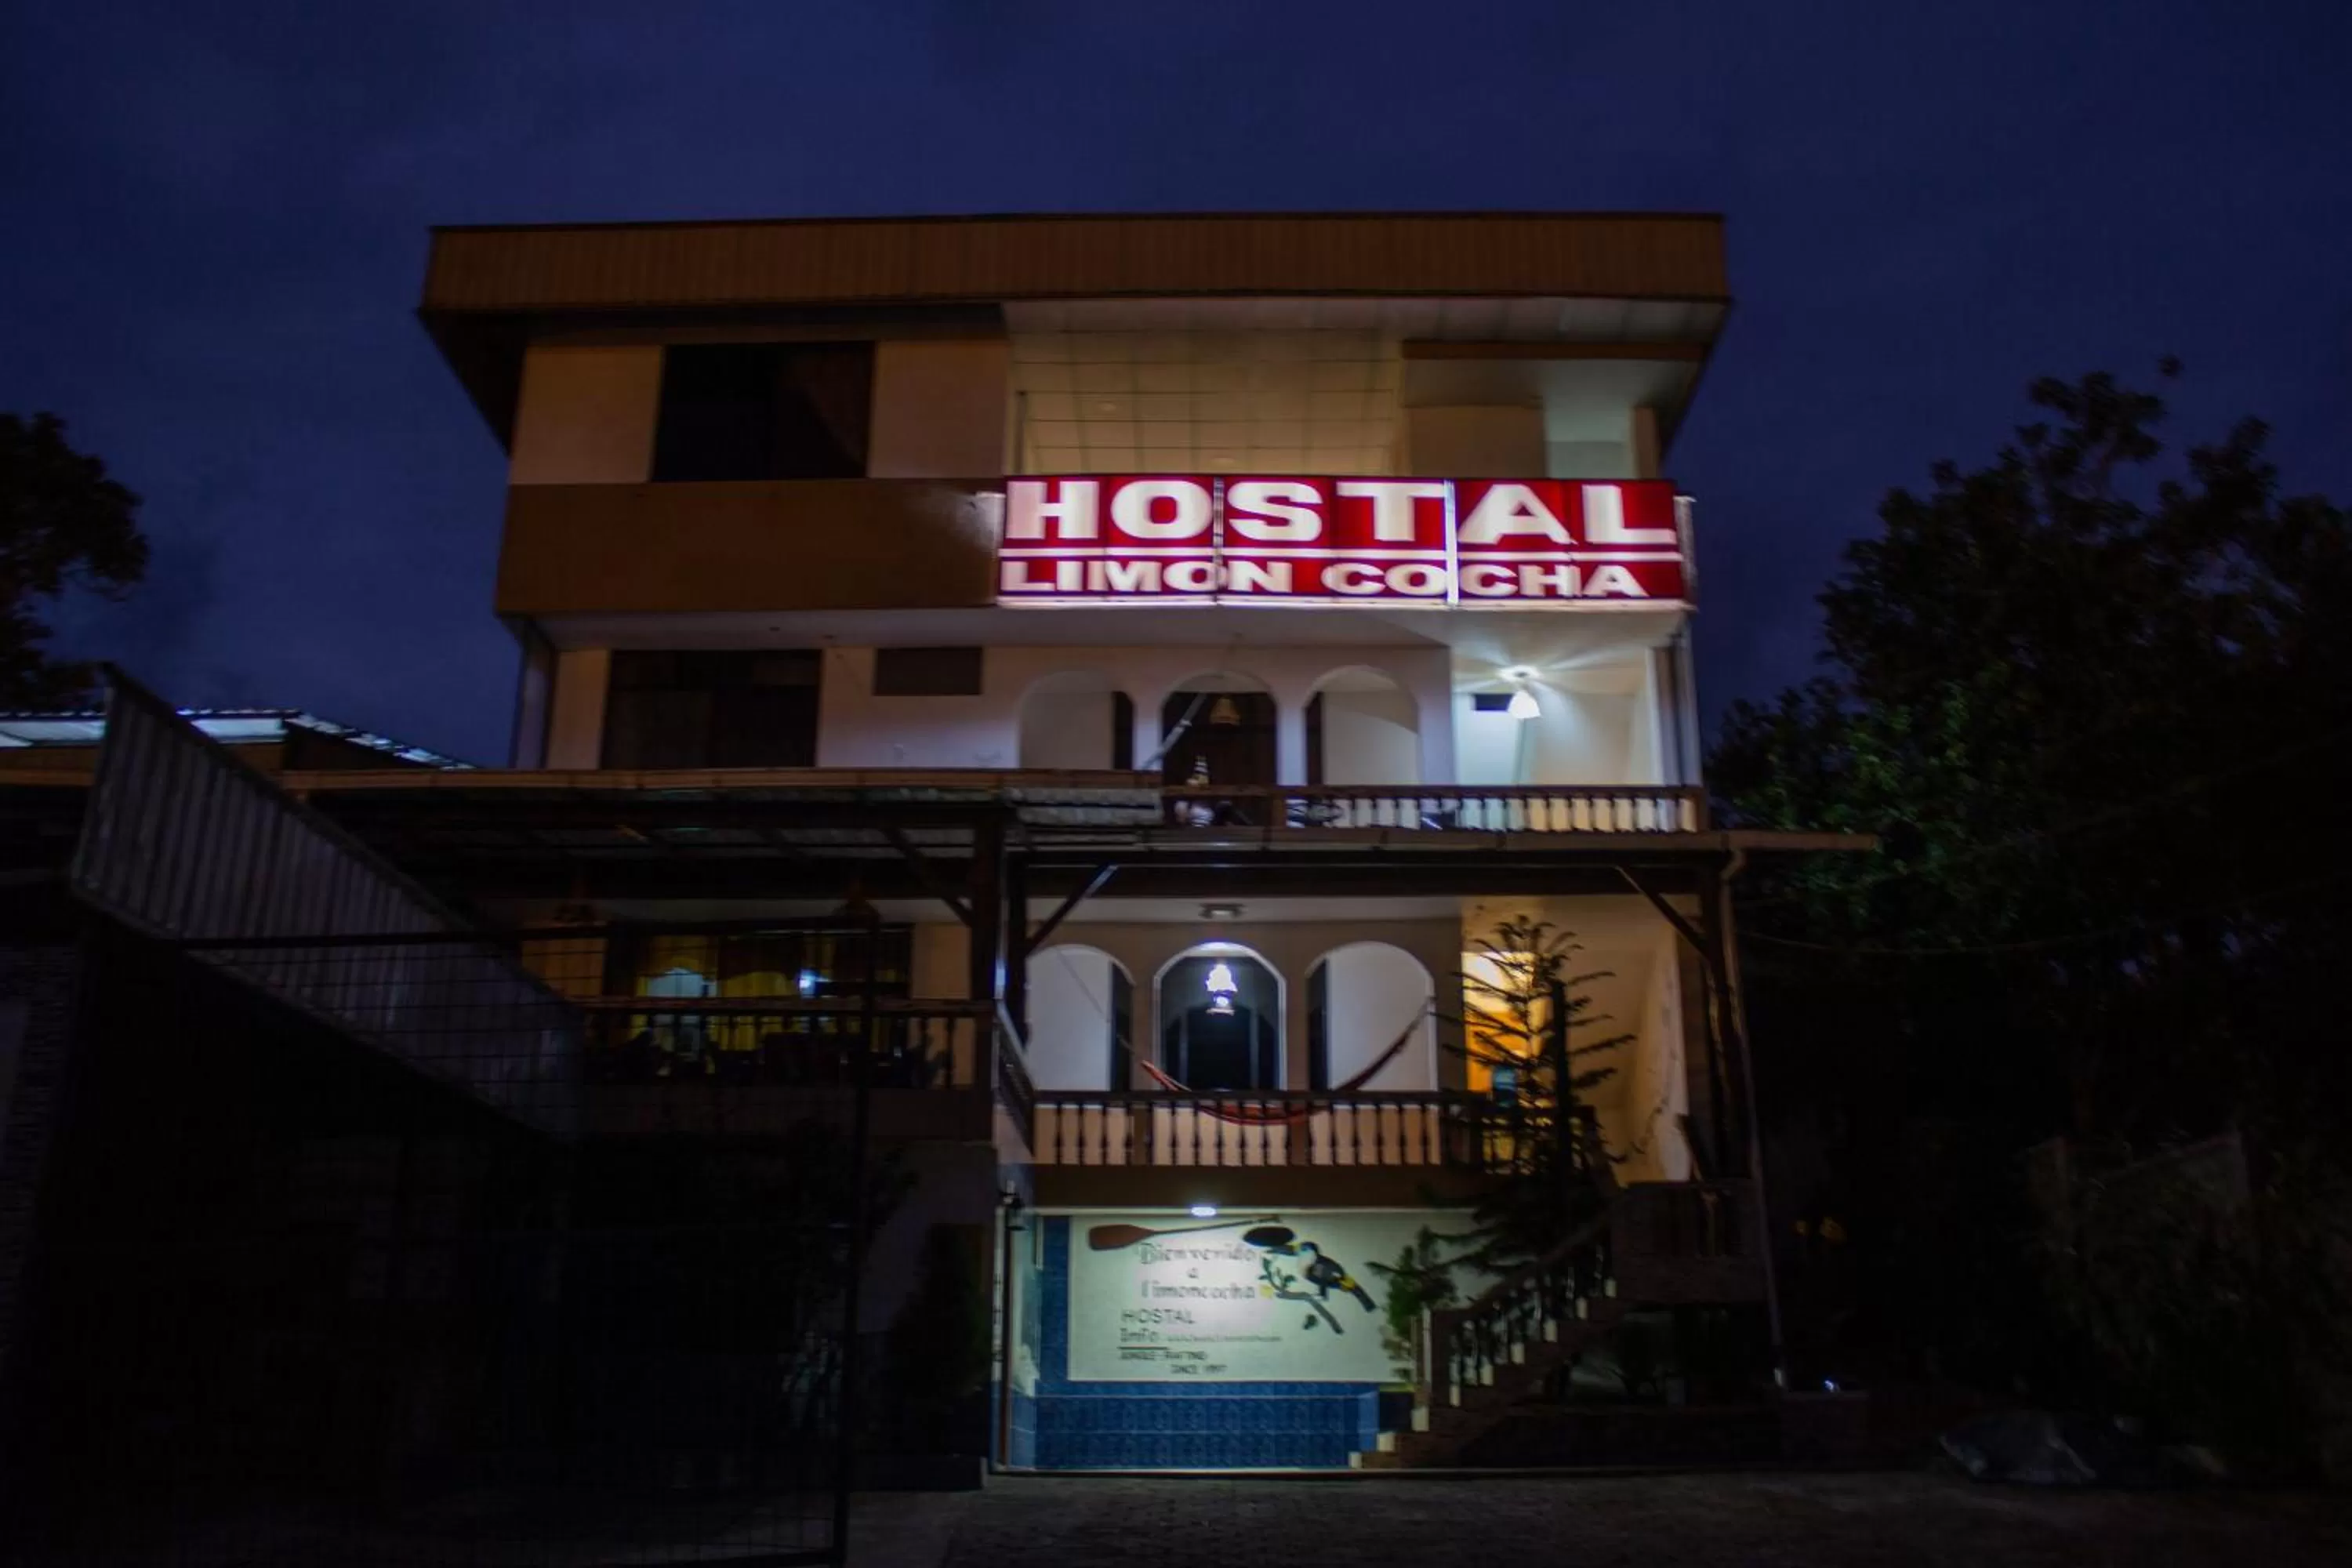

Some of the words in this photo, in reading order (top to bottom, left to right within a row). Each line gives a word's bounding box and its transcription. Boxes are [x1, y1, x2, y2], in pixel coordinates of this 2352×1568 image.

[1006, 480, 1676, 545] HOSTAL
[1000, 560, 1294, 593] LIMON
[1321, 563, 1650, 597] COCHA
[1122, 1308, 1196, 1324] HOSTAL
